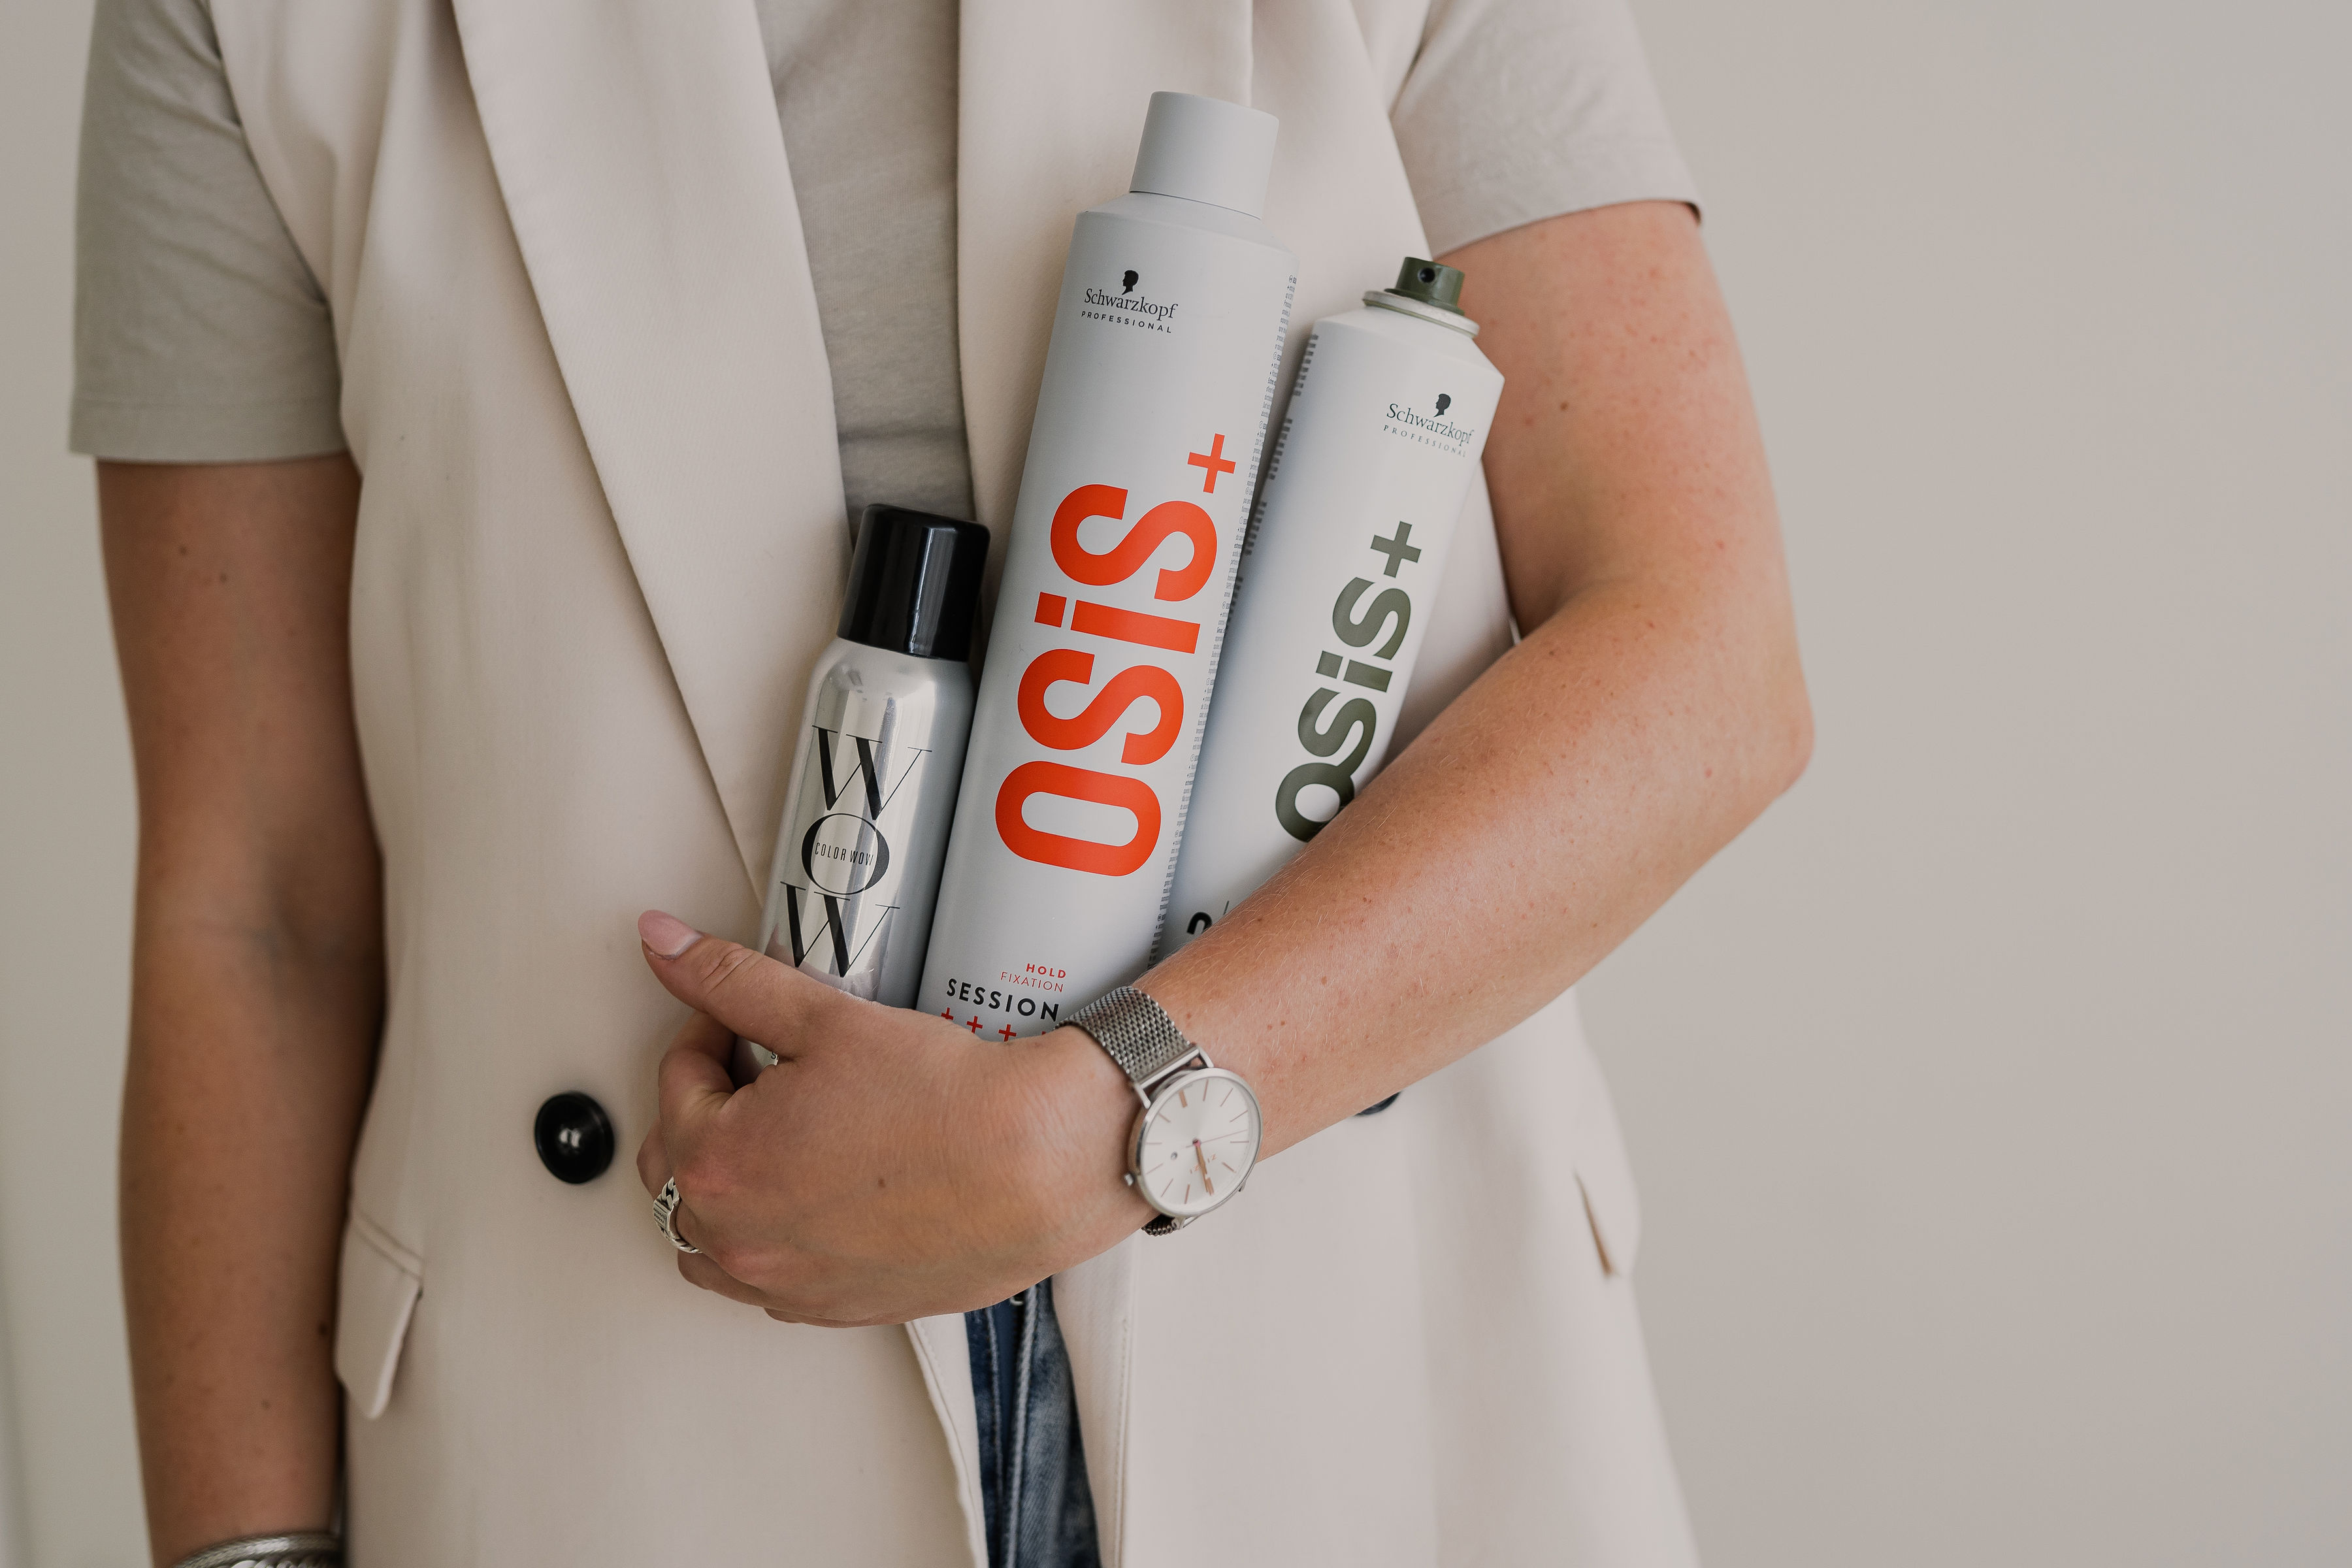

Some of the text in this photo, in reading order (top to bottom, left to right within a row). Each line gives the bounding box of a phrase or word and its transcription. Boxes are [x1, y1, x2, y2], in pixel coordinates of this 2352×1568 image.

[1084, 287, 1179, 321] Schwarzkopf
[1081, 310, 1172, 334] PROFESSIONAL
[1386, 402, 1475, 447] Schwarzkopf
[1382, 424, 1466, 457] PROFESSIONAL
[815, 841, 874, 866] COLOR WOW
[1000, 971, 1064, 994] FIXATION
[1025, 962, 1067, 979] HOLD
[945, 977, 1060, 1022] SESSION
